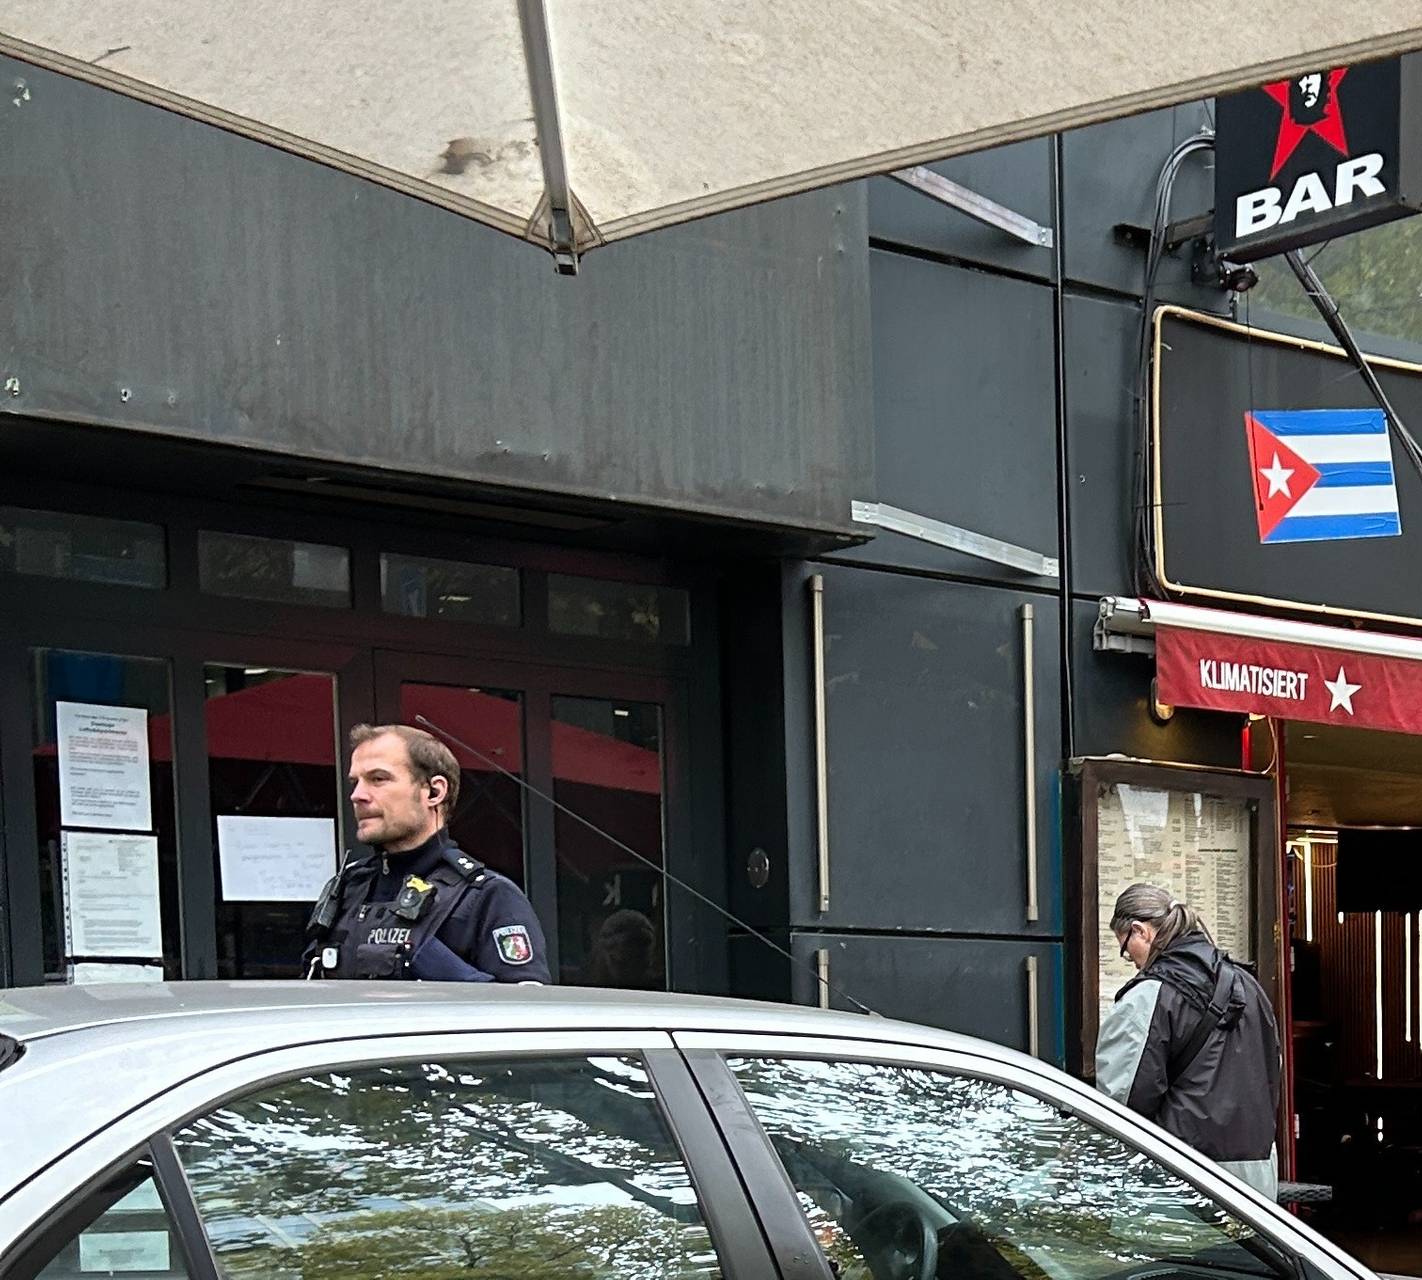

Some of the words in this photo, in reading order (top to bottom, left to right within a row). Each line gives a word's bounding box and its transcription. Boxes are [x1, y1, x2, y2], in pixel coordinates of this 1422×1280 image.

[1235, 152, 1387, 239] BAR
[1199, 658, 1309, 702] KLIMATISIERT
[367, 927, 412, 945] POLIZEI
